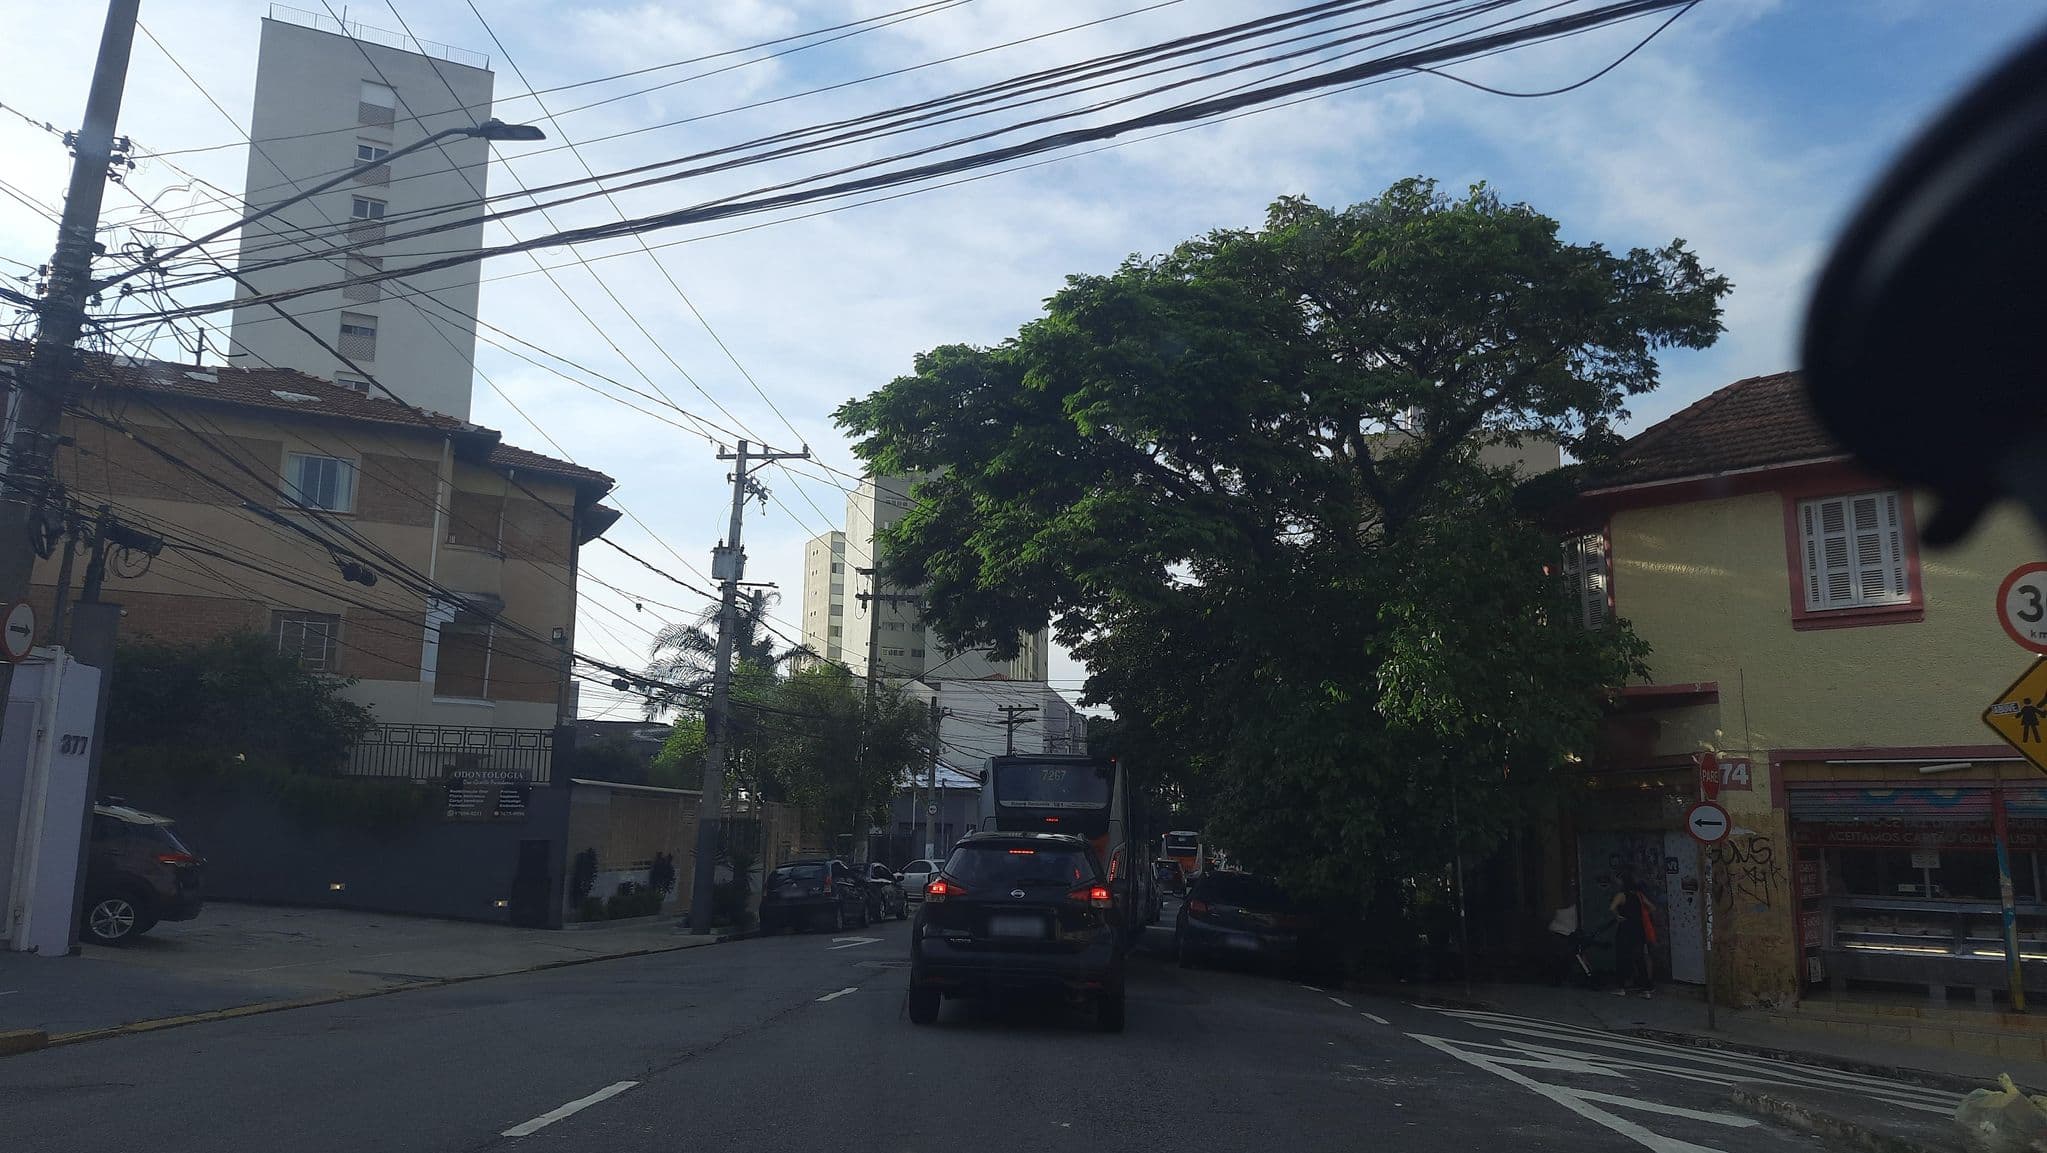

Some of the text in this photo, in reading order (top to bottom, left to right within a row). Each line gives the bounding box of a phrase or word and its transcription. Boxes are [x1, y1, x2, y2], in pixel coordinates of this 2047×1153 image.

[2017, 585, 2047, 623] 3
[61, 733, 89, 755] 377
[454, 771, 523, 779] ODONTOLOGIA
[1041, 769, 1067, 781] 7267
[1702, 769, 1719, 784] PARE
[1719, 763, 1749, 785] 74
